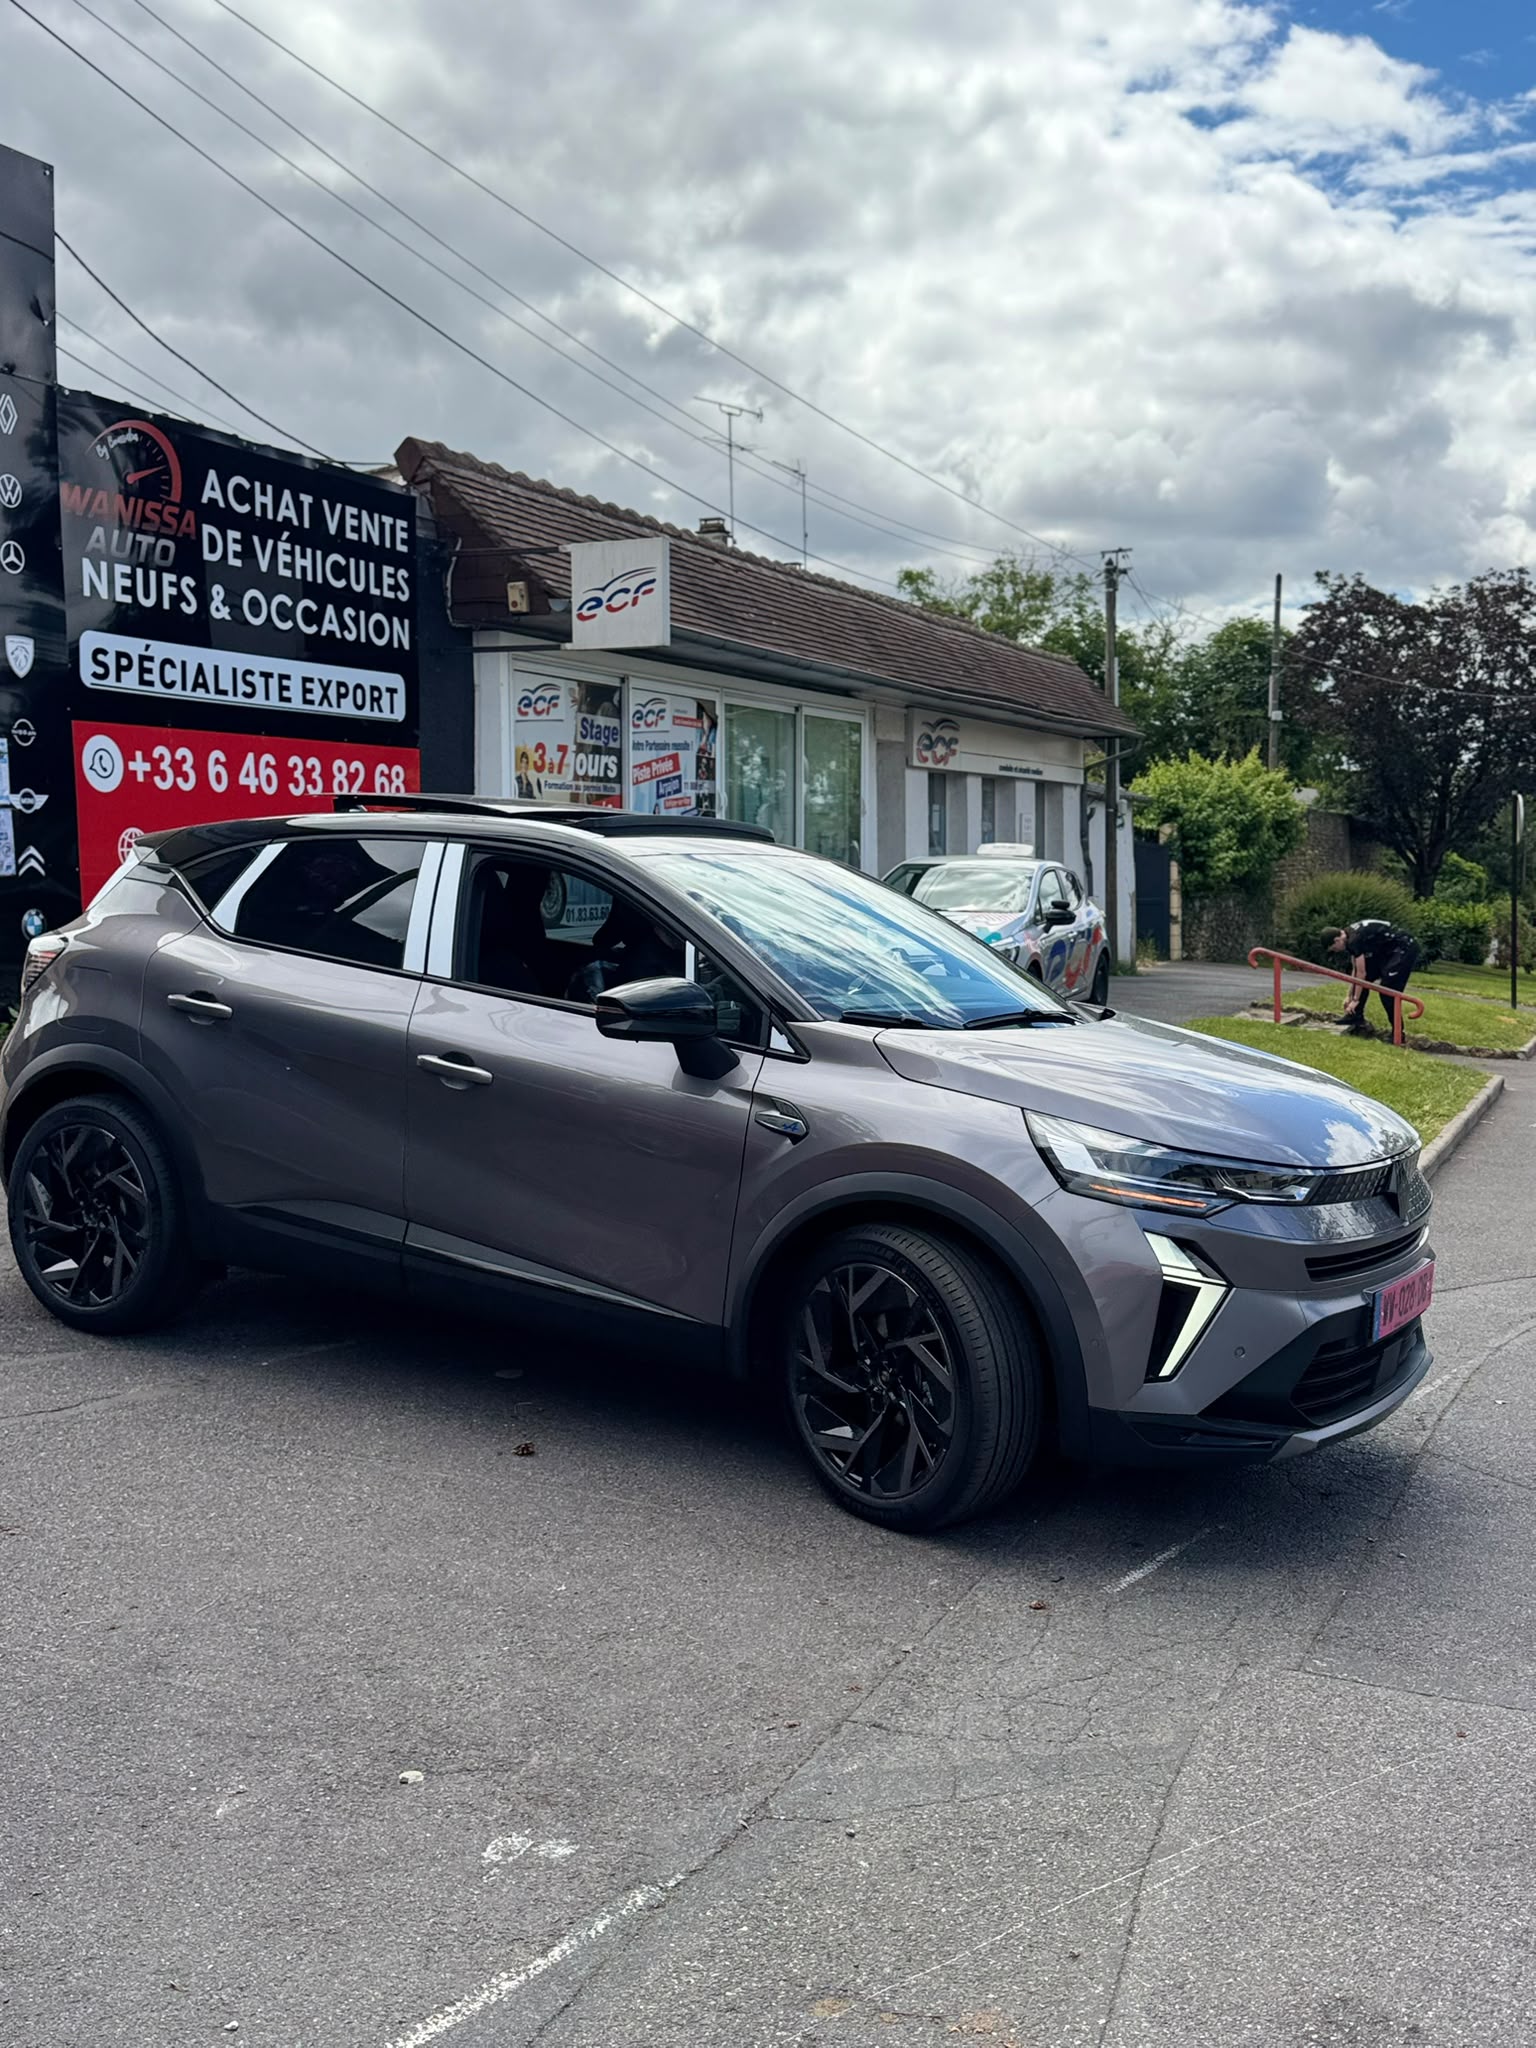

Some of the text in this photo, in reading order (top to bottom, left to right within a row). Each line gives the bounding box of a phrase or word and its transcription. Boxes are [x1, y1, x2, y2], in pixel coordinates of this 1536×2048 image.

[61, 482, 197, 540] WANISSA
[201, 469, 409, 553] ACHAT VENTE
[85, 525, 176, 567] AUTO
[202, 523, 410, 602] DE VÉHICULES
[82, 557, 410, 650] NEUFS & OCCASION
[91, 644, 398, 715] SPÉCIALISTE EXPORT
[580, 717, 619, 748] Stage
[128, 745, 405, 796] +33 6 46 33 82 68
[533, 742, 546, 773] 3
[557, 744, 568, 775] 7
[652, 757, 674, 776] Privée
[544, 780, 573, 791] Formation
